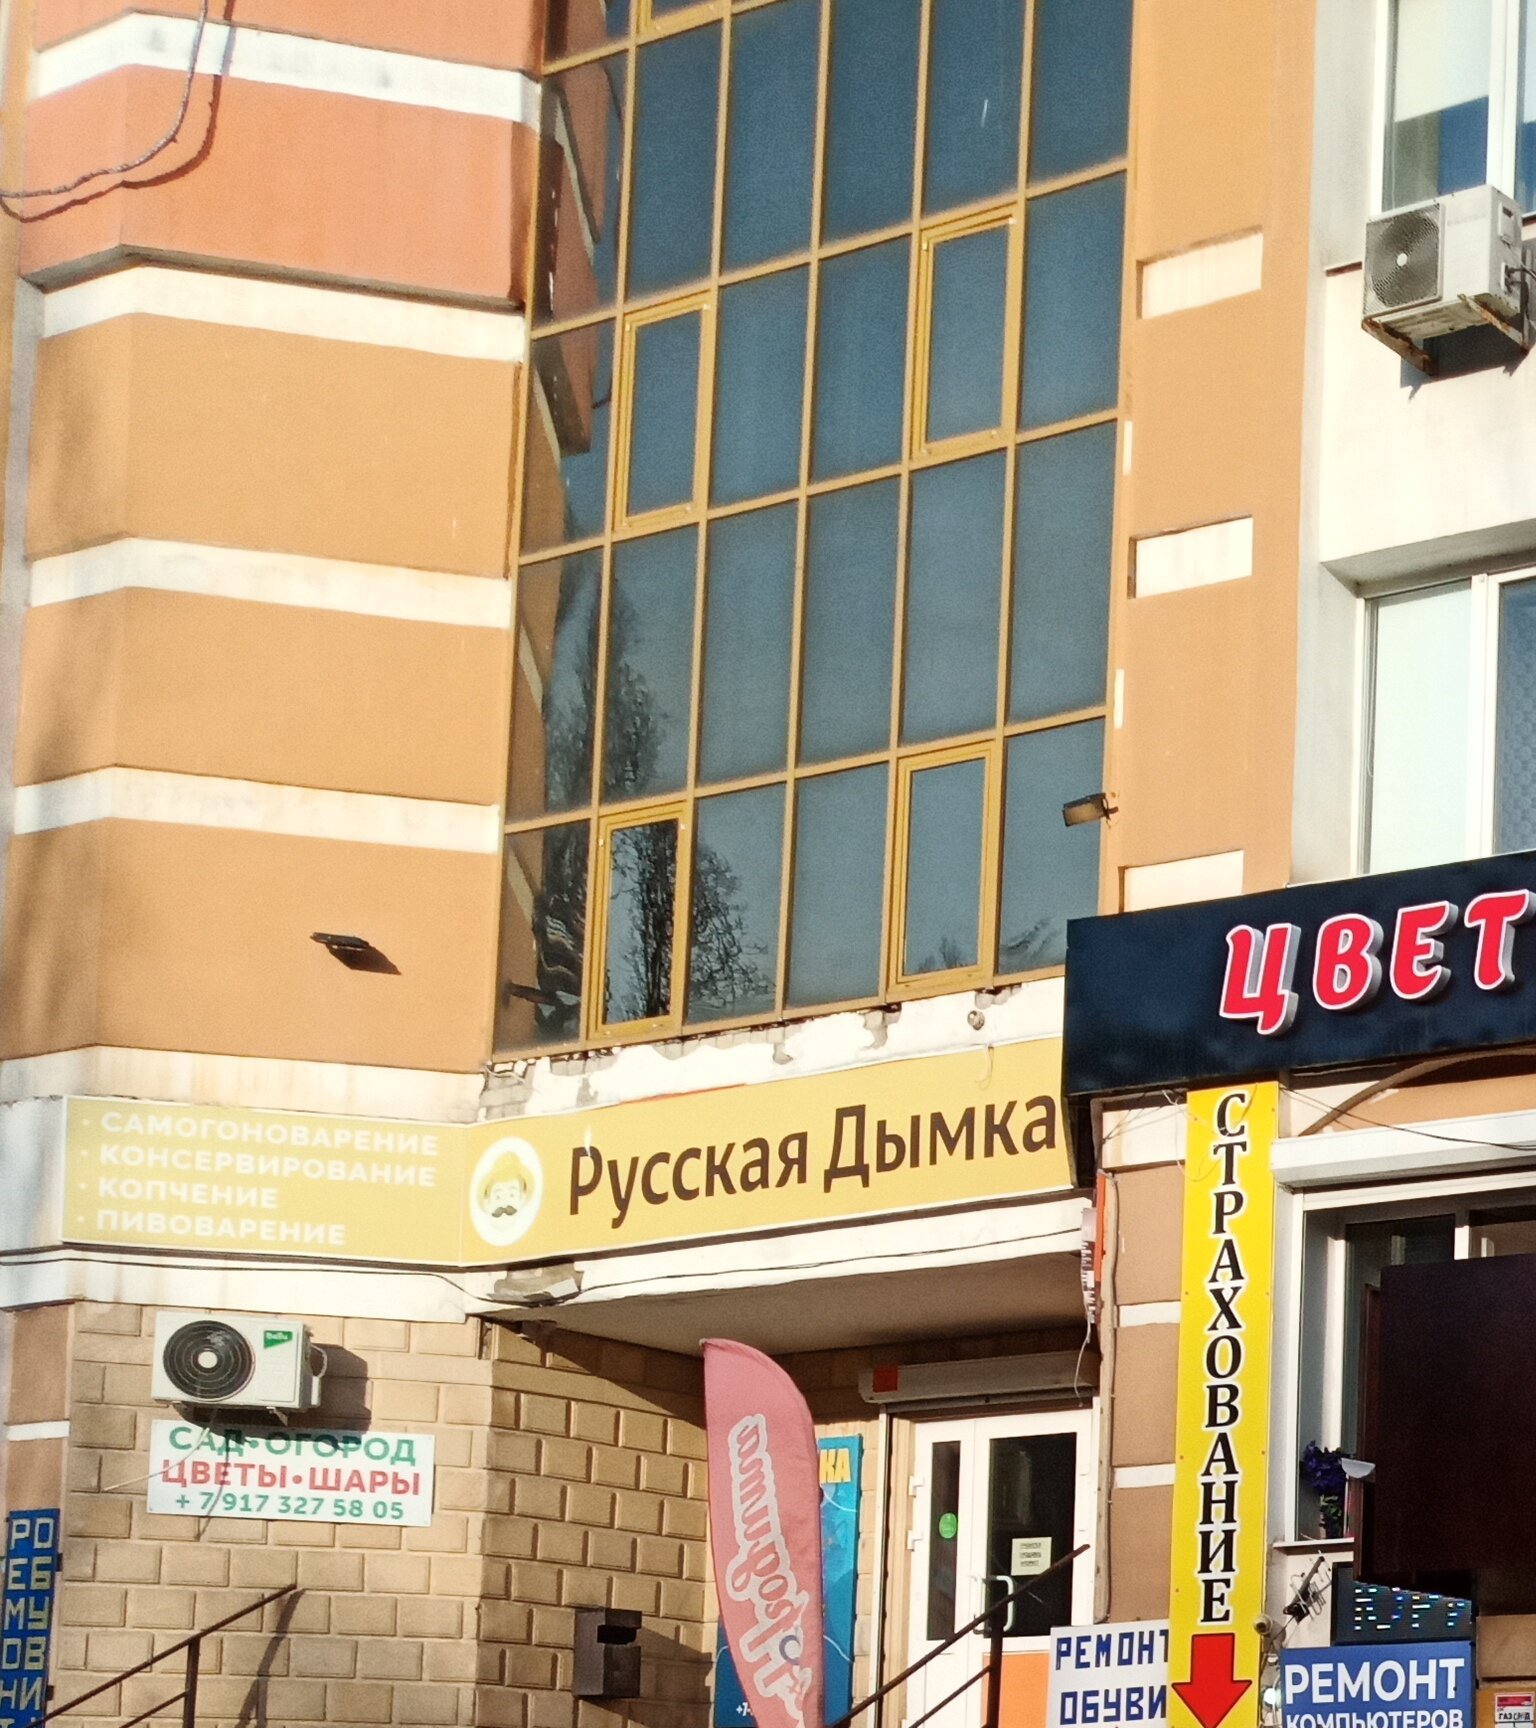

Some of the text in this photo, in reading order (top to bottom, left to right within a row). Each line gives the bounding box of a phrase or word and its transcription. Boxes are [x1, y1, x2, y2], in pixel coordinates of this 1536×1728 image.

[101, 1111, 439, 1156] САМОГОНОВАРЕНИЕ
[100, 1143, 436, 1188] КОНСЕРВИРОВАНИЕ
[569, 1094, 1057, 1230] Русская Дымка
[98, 1177, 279, 1209] КОПЧЕНИЕ
[96, 1209, 346, 1247] ПИВОВАРЕНИЕ
[1199, 1092, 1248, 1624] СТРАХОВАНИЕ
[222, 1492, 269, 1513] 917
[278, 1497, 323, 1514] 327
[333, 1499, 363, 1518] 58
[373, 1501, 404, 1520] 05
[1056, 1629, 1169, 1671] РЕМОНТ
[1284, 1657, 1465, 1705] РЕМОНТ
[1060, 1685, 1167, 1726] ОБУВИ
